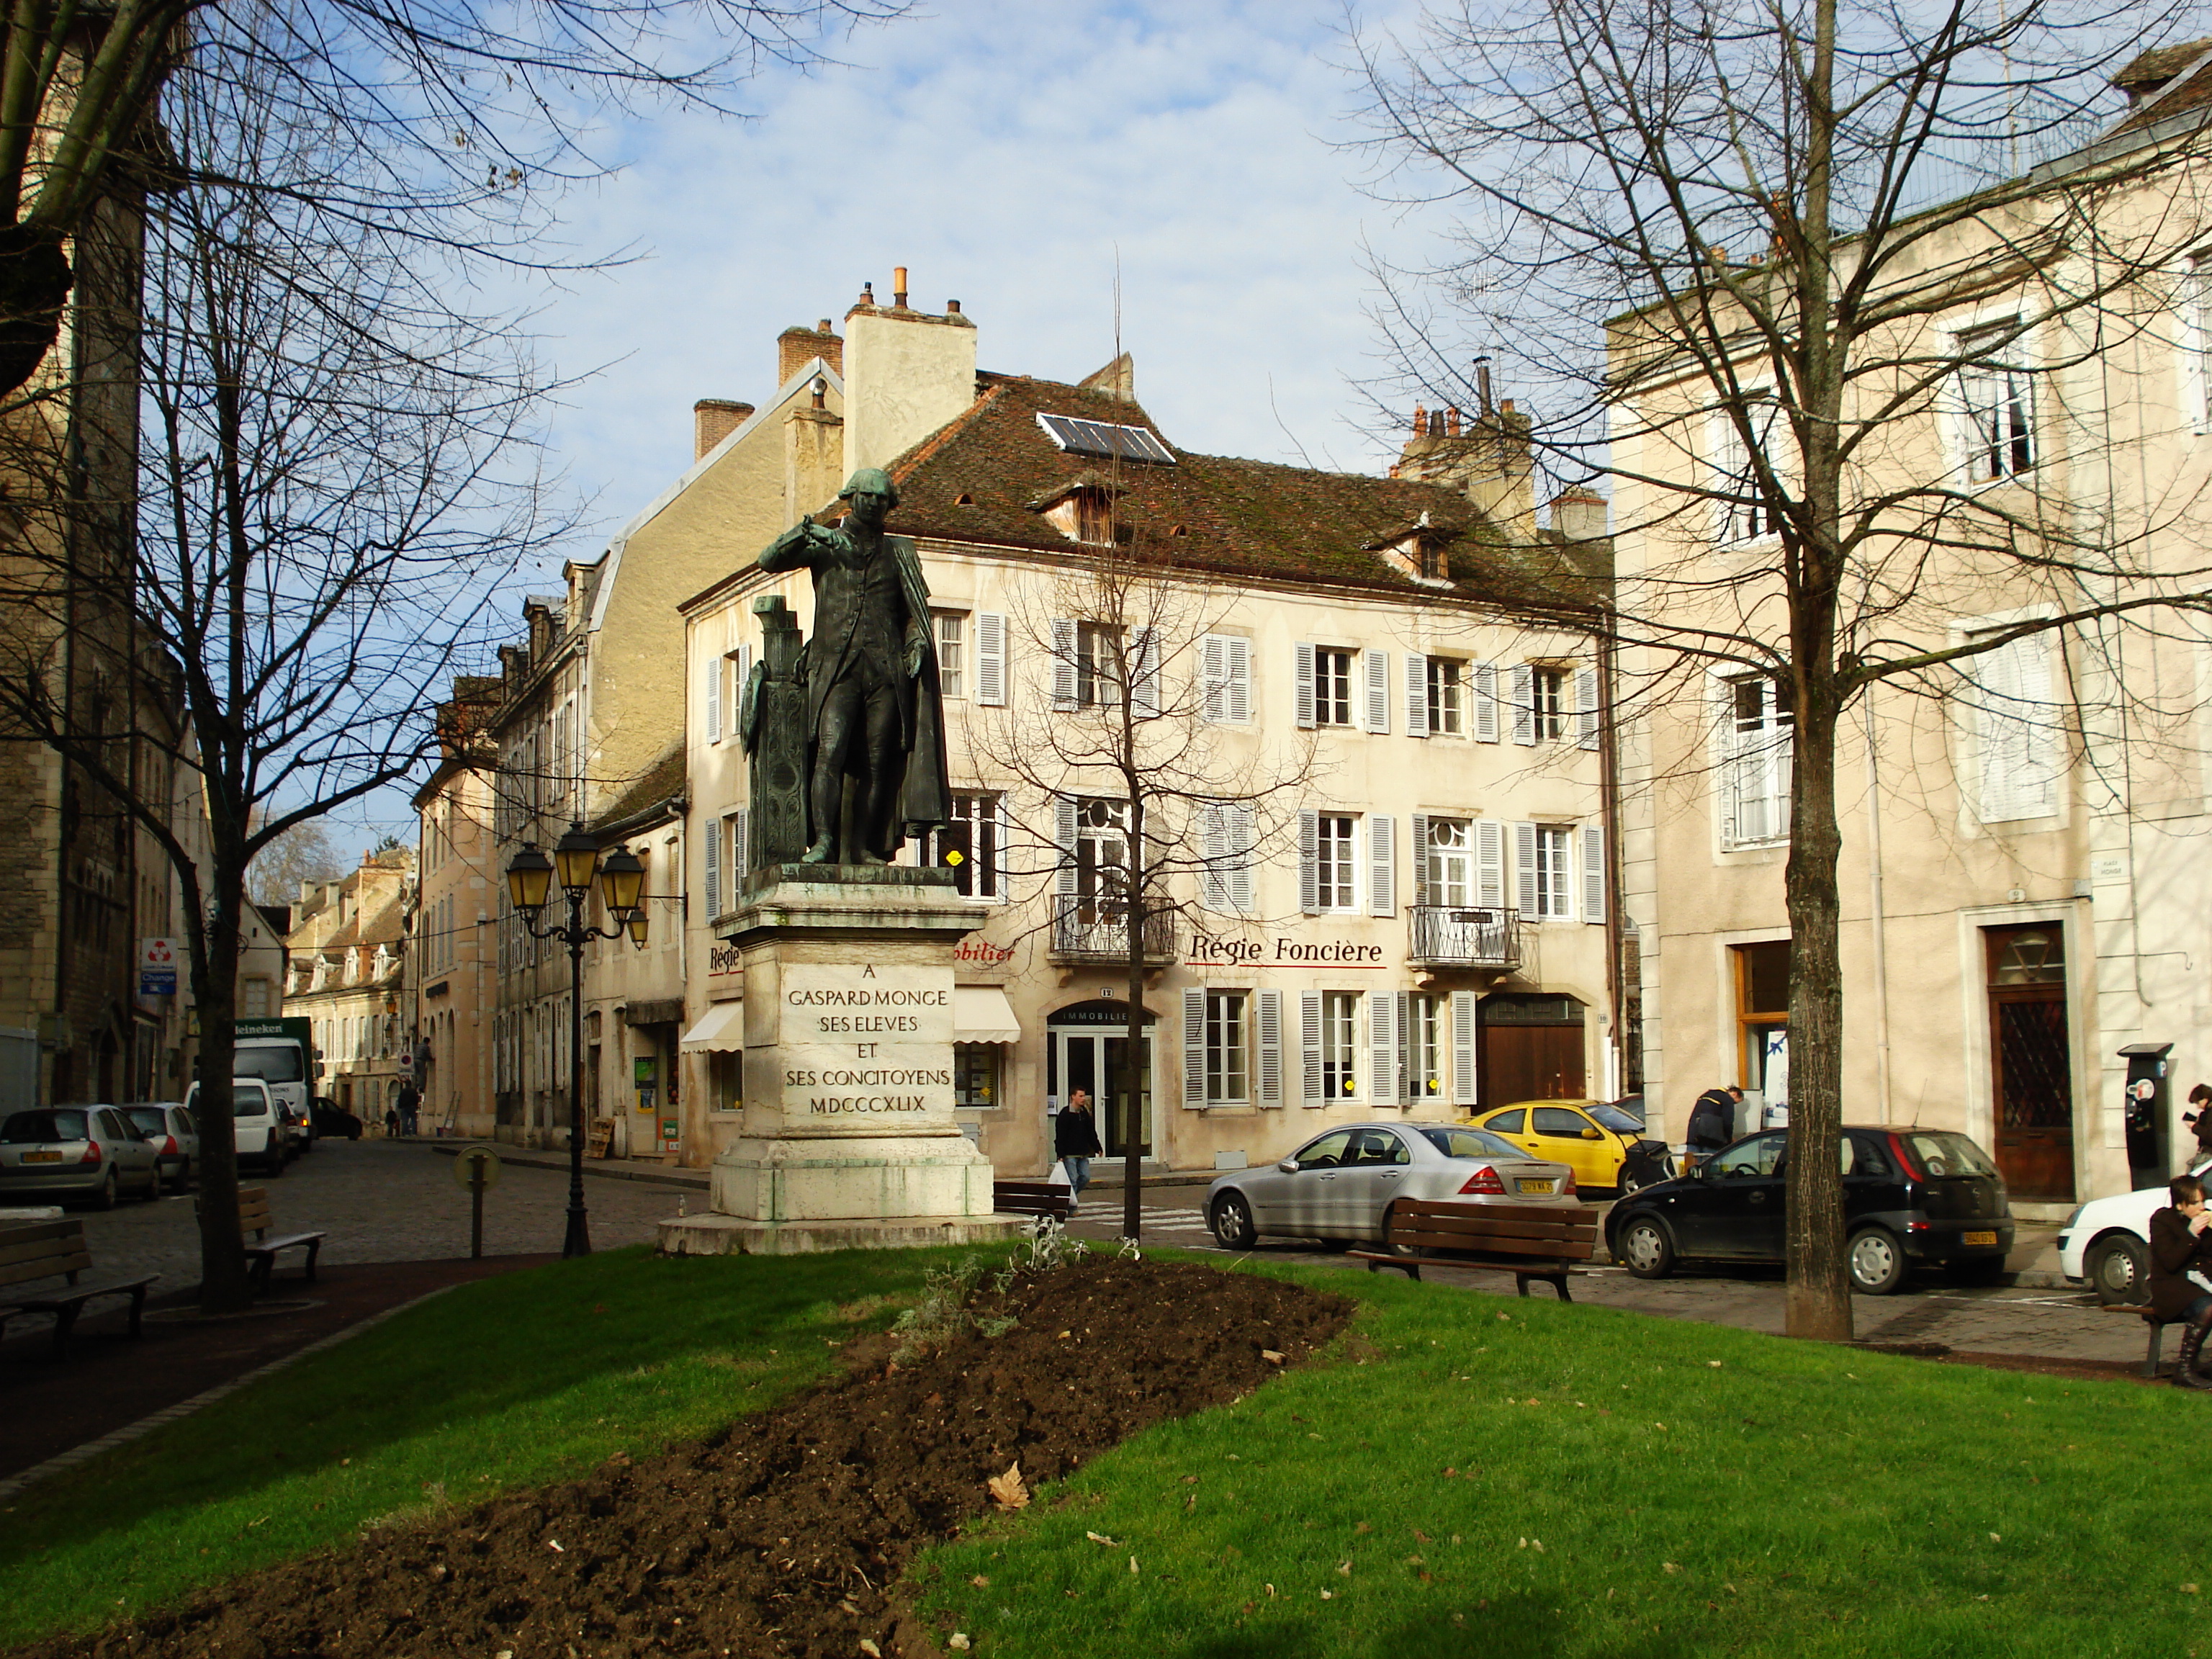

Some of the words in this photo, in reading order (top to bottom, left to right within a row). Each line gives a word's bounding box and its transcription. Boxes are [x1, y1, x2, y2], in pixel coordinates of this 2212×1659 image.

[953, 942, 1015, 961] obilier
[1190, 935, 1263, 966] Régie
[1274, 938, 1382, 962] Foncière
[710, 946, 739, 974] Régie
[143, 974, 175, 983] Change
[862, 963, 876, 979] A
[788, 990, 871, 1006] GASPARD
[874, 990, 948, 1006] MONGE
[819, 1016, 850, 1032] SES
[855, 1016, 918, 1032] ELEVES
[1063, 1012, 1128, 1020] IMMOBILIE
[857, 1043, 878, 1058] ET
[786, 1070, 817, 1087] SES
[822, 1069, 950, 1086] CONCITOYENS
[810, 1096, 926, 1113] MDCCCXLIX
